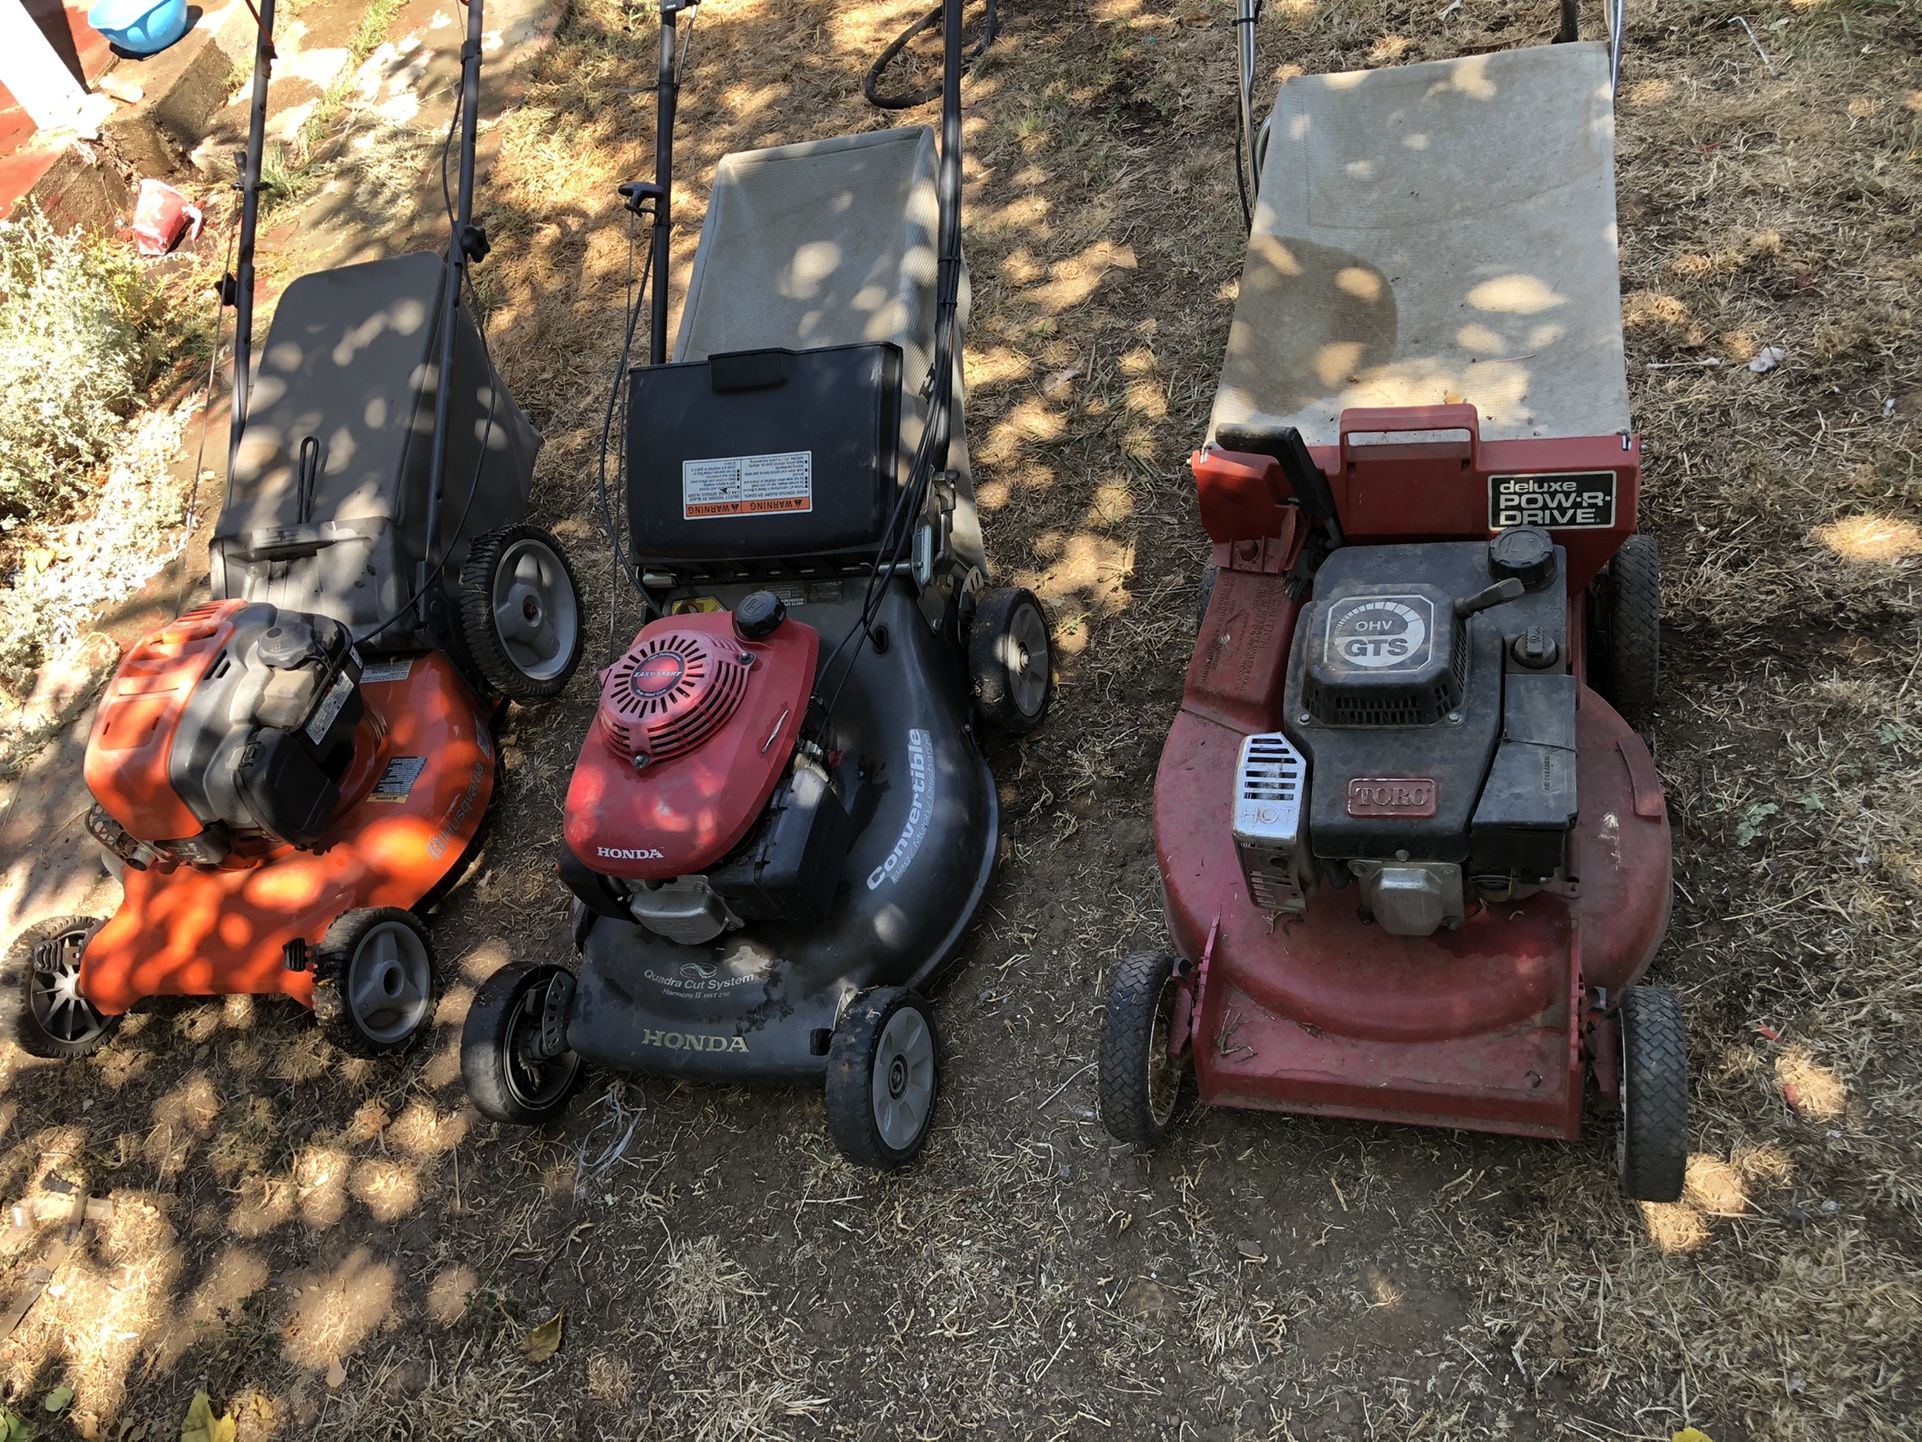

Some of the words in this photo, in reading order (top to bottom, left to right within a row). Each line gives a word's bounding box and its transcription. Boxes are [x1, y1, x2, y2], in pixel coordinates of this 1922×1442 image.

[1499, 480, 1577, 493] deluxe
[688, 505, 730, 515] WARNING
[749, 500, 793, 511] WARNING
[1499, 508, 1597, 526] DRIVE
[1355, 620, 1393, 632] OHV
[1344, 637, 1409, 657] GTS
[441, 762, 484, 840] Husqvarna
[1355, 786, 1430, 807] TORO
[866, 729, 925, 890] Convertible
[1240, 803, 1296, 825] HOT
[597, 846, 664, 860] HONDA
[644, 969, 682, 988] Quadra
[684, 979, 706, 990] Cut
[707, 973, 755, 991] System
[662, 988, 694, 999] Harmony
[641, 1028, 750, 1053] HONDA
